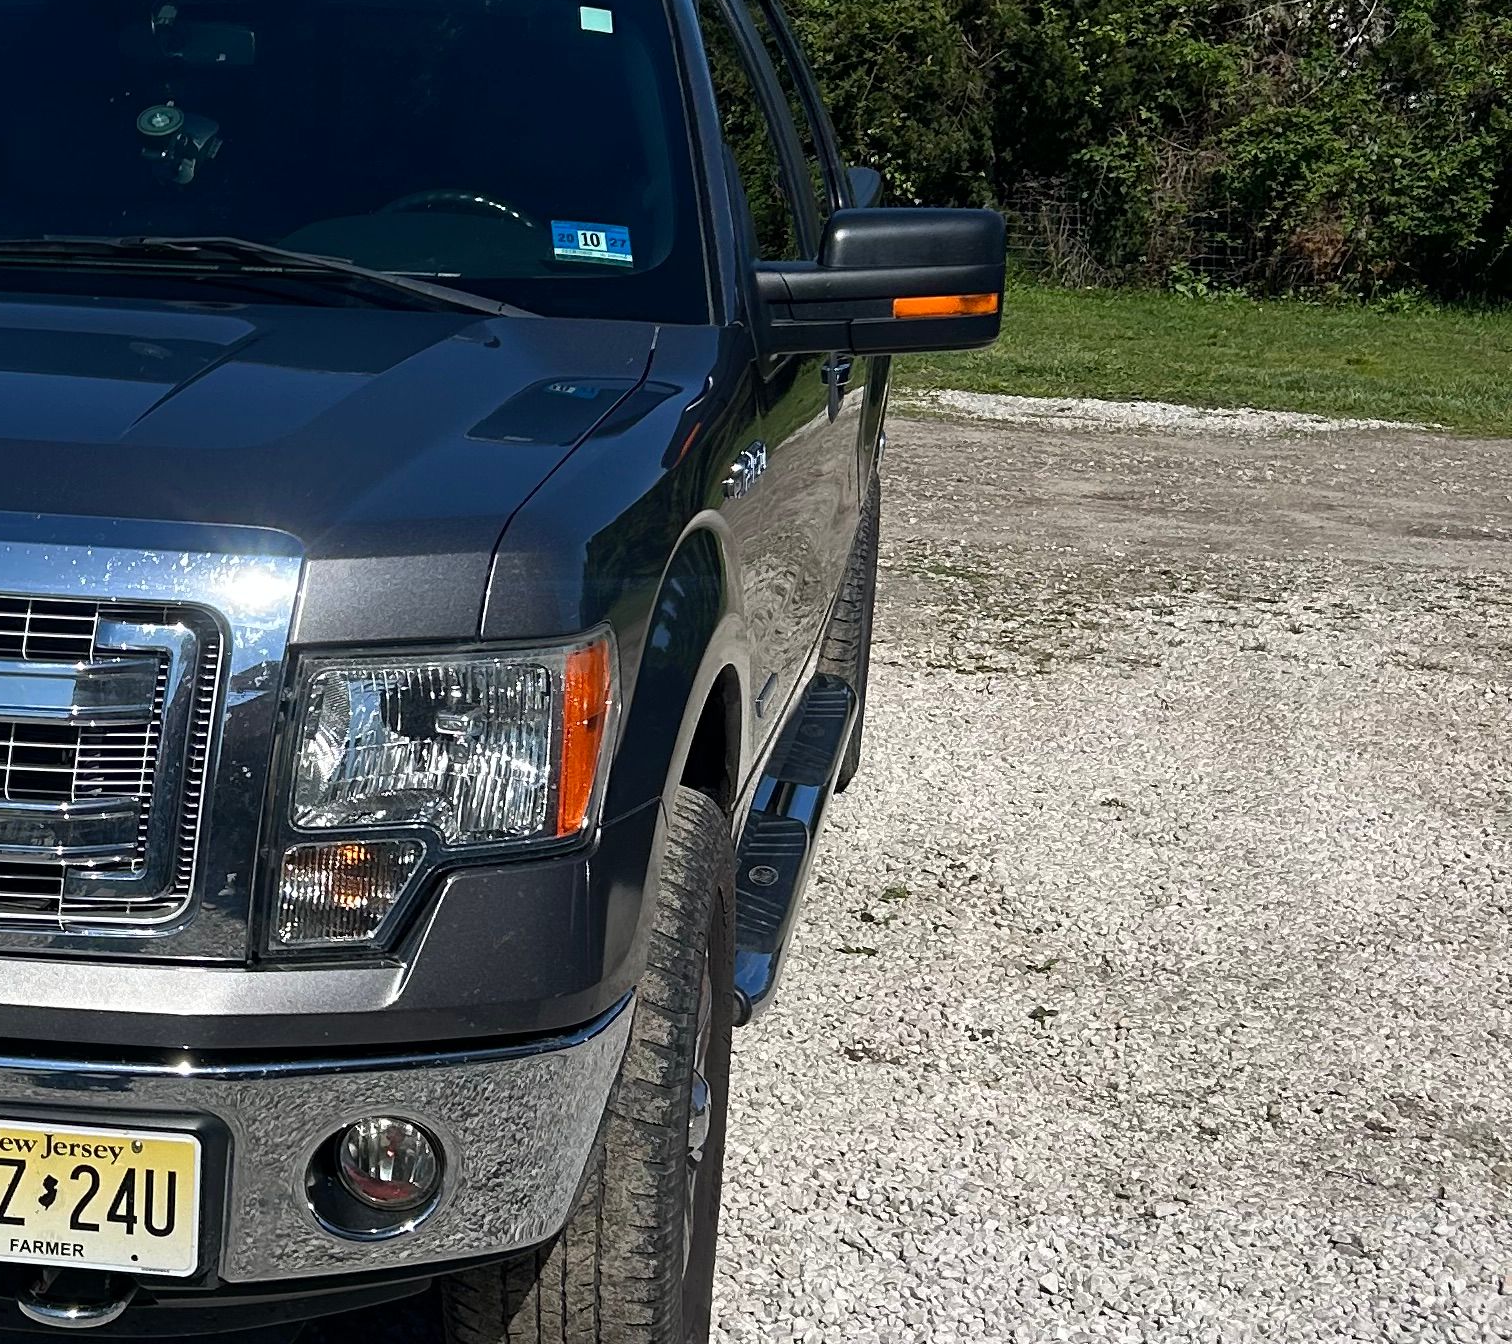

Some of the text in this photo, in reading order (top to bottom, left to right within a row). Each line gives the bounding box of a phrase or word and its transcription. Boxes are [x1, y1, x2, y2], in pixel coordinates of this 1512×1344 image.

[581, 232, 600, 247] 10
[41, 1133, 124, 1165] Jersey
[70, 1164, 177, 1237] 24U
[10, 1238, 84, 1257] FARMER
